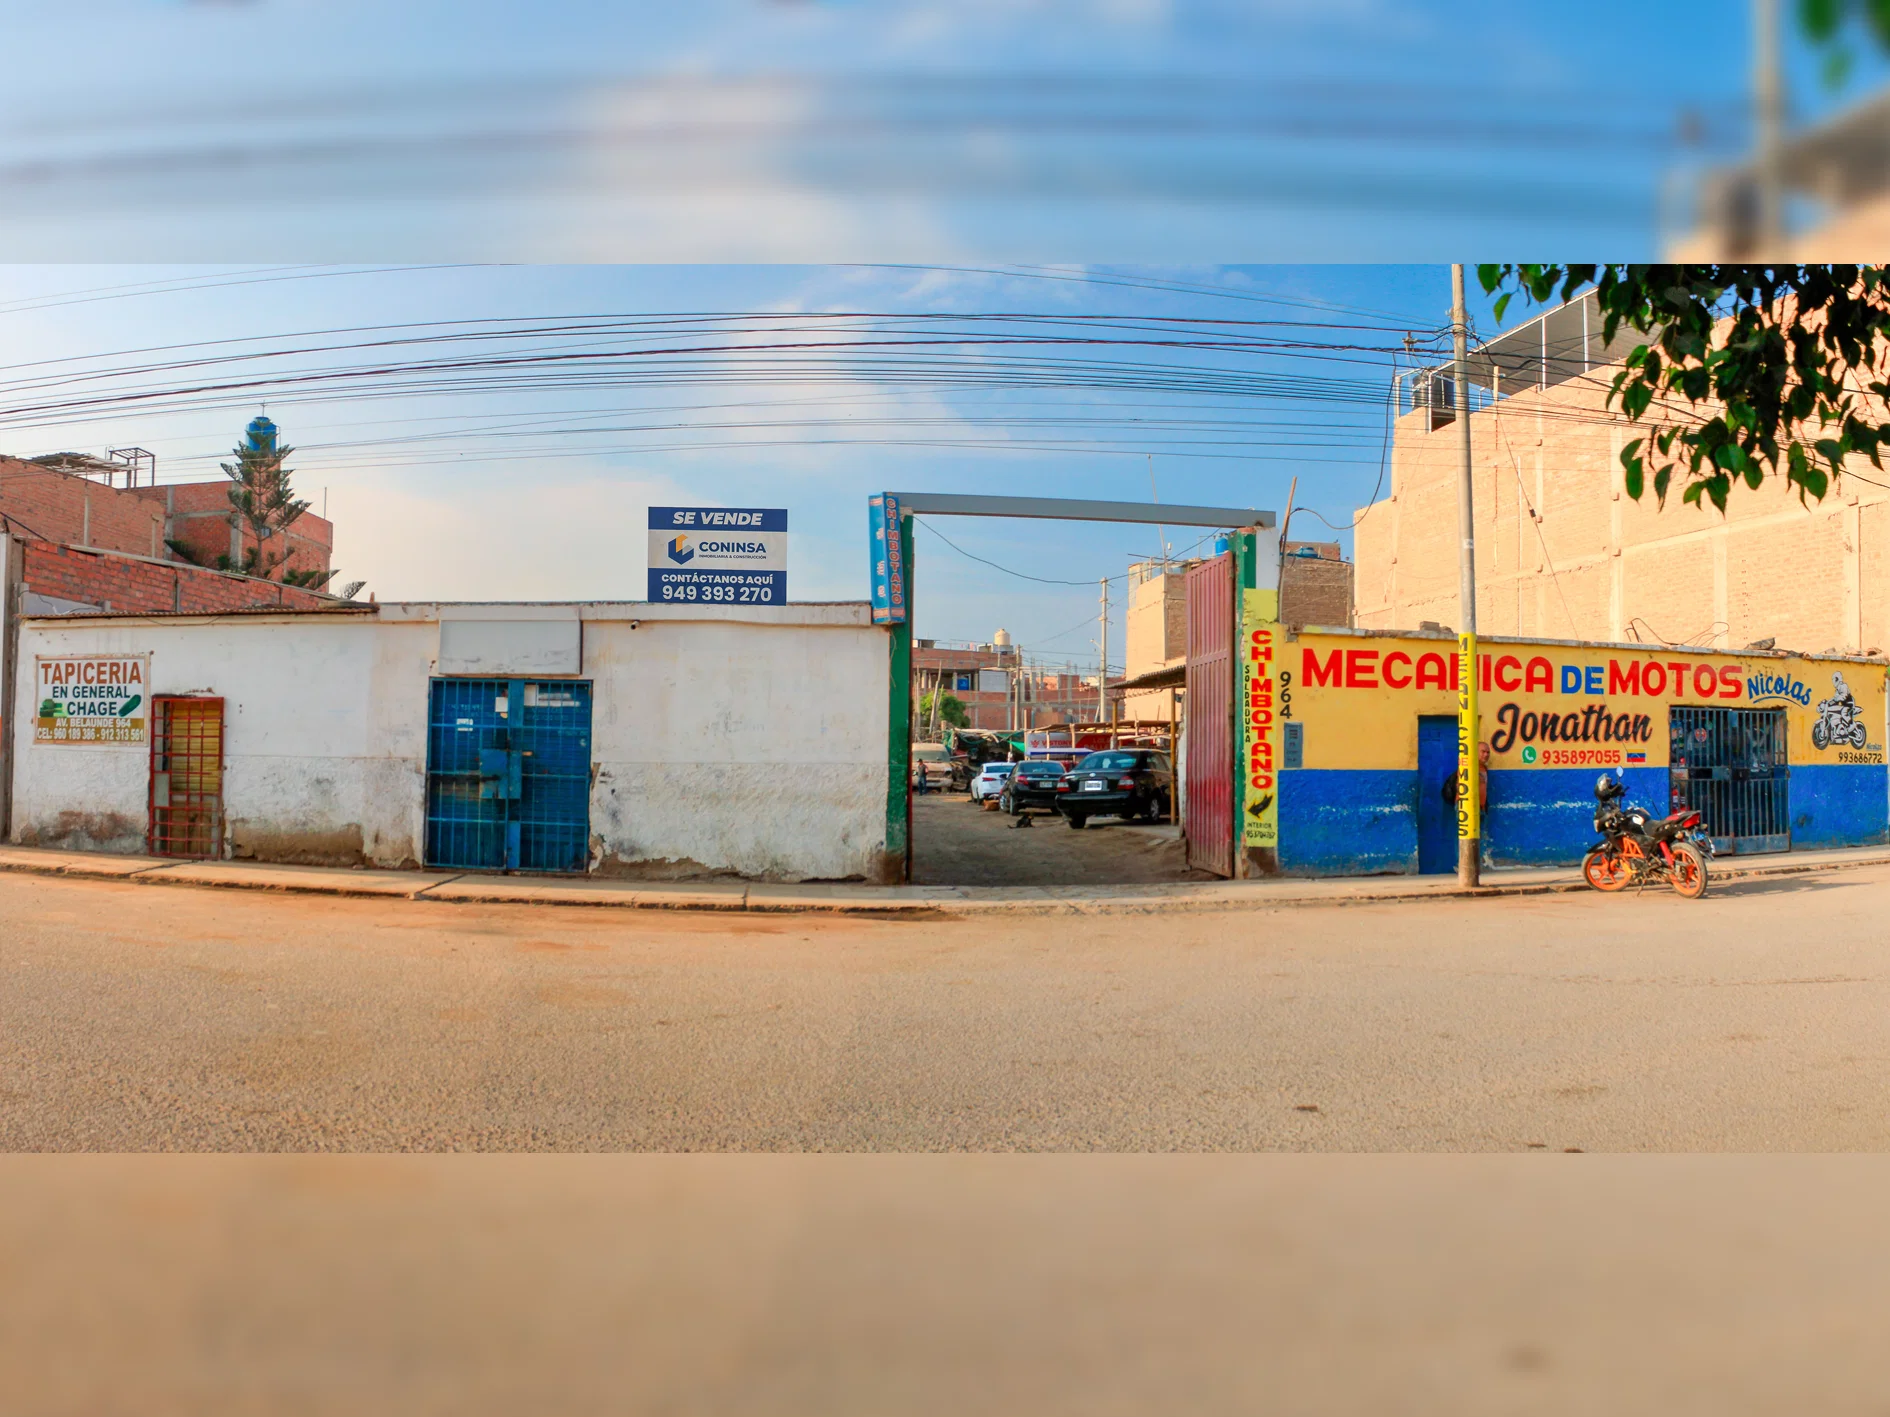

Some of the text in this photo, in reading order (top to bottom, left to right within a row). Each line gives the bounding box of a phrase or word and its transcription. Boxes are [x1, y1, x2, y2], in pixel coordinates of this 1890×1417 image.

[672, 511, 763, 526] SE VENDE
[699, 541, 767, 553] CONINSA
[886, 498, 903, 605] CHIMBOTANO
[661, 572, 773, 585] CONTÁCTANOS AQUÍ
[662, 585, 772, 601] 949 393 270
[41, 661, 142, 684] TAPICERIA
[1562, 665, 1604, 695] DE
[1609, 659, 1743, 698] MOTOS
[52, 686, 130, 698] EN GENERAL
[1279, 671, 1292, 719] 964
[1747, 673, 1812, 706] Nicolas
[67, 701, 117, 716] CHAGE
[1251, 629, 1273, 790] CHIMBOTANO
[56, 718, 131, 728] AV. BELAUNDE 964
[1491, 703, 1653, 753] Jonathan
[37, 728, 52, 739] CEL:
[101, 728, 114, 740] 912
[116, 728, 129, 740] 313
[1042, 740, 1073, 748] VSTONY
[1542, 749, 1621, 764] 935897055
[1838, 752, 1883, 764] 993686772
